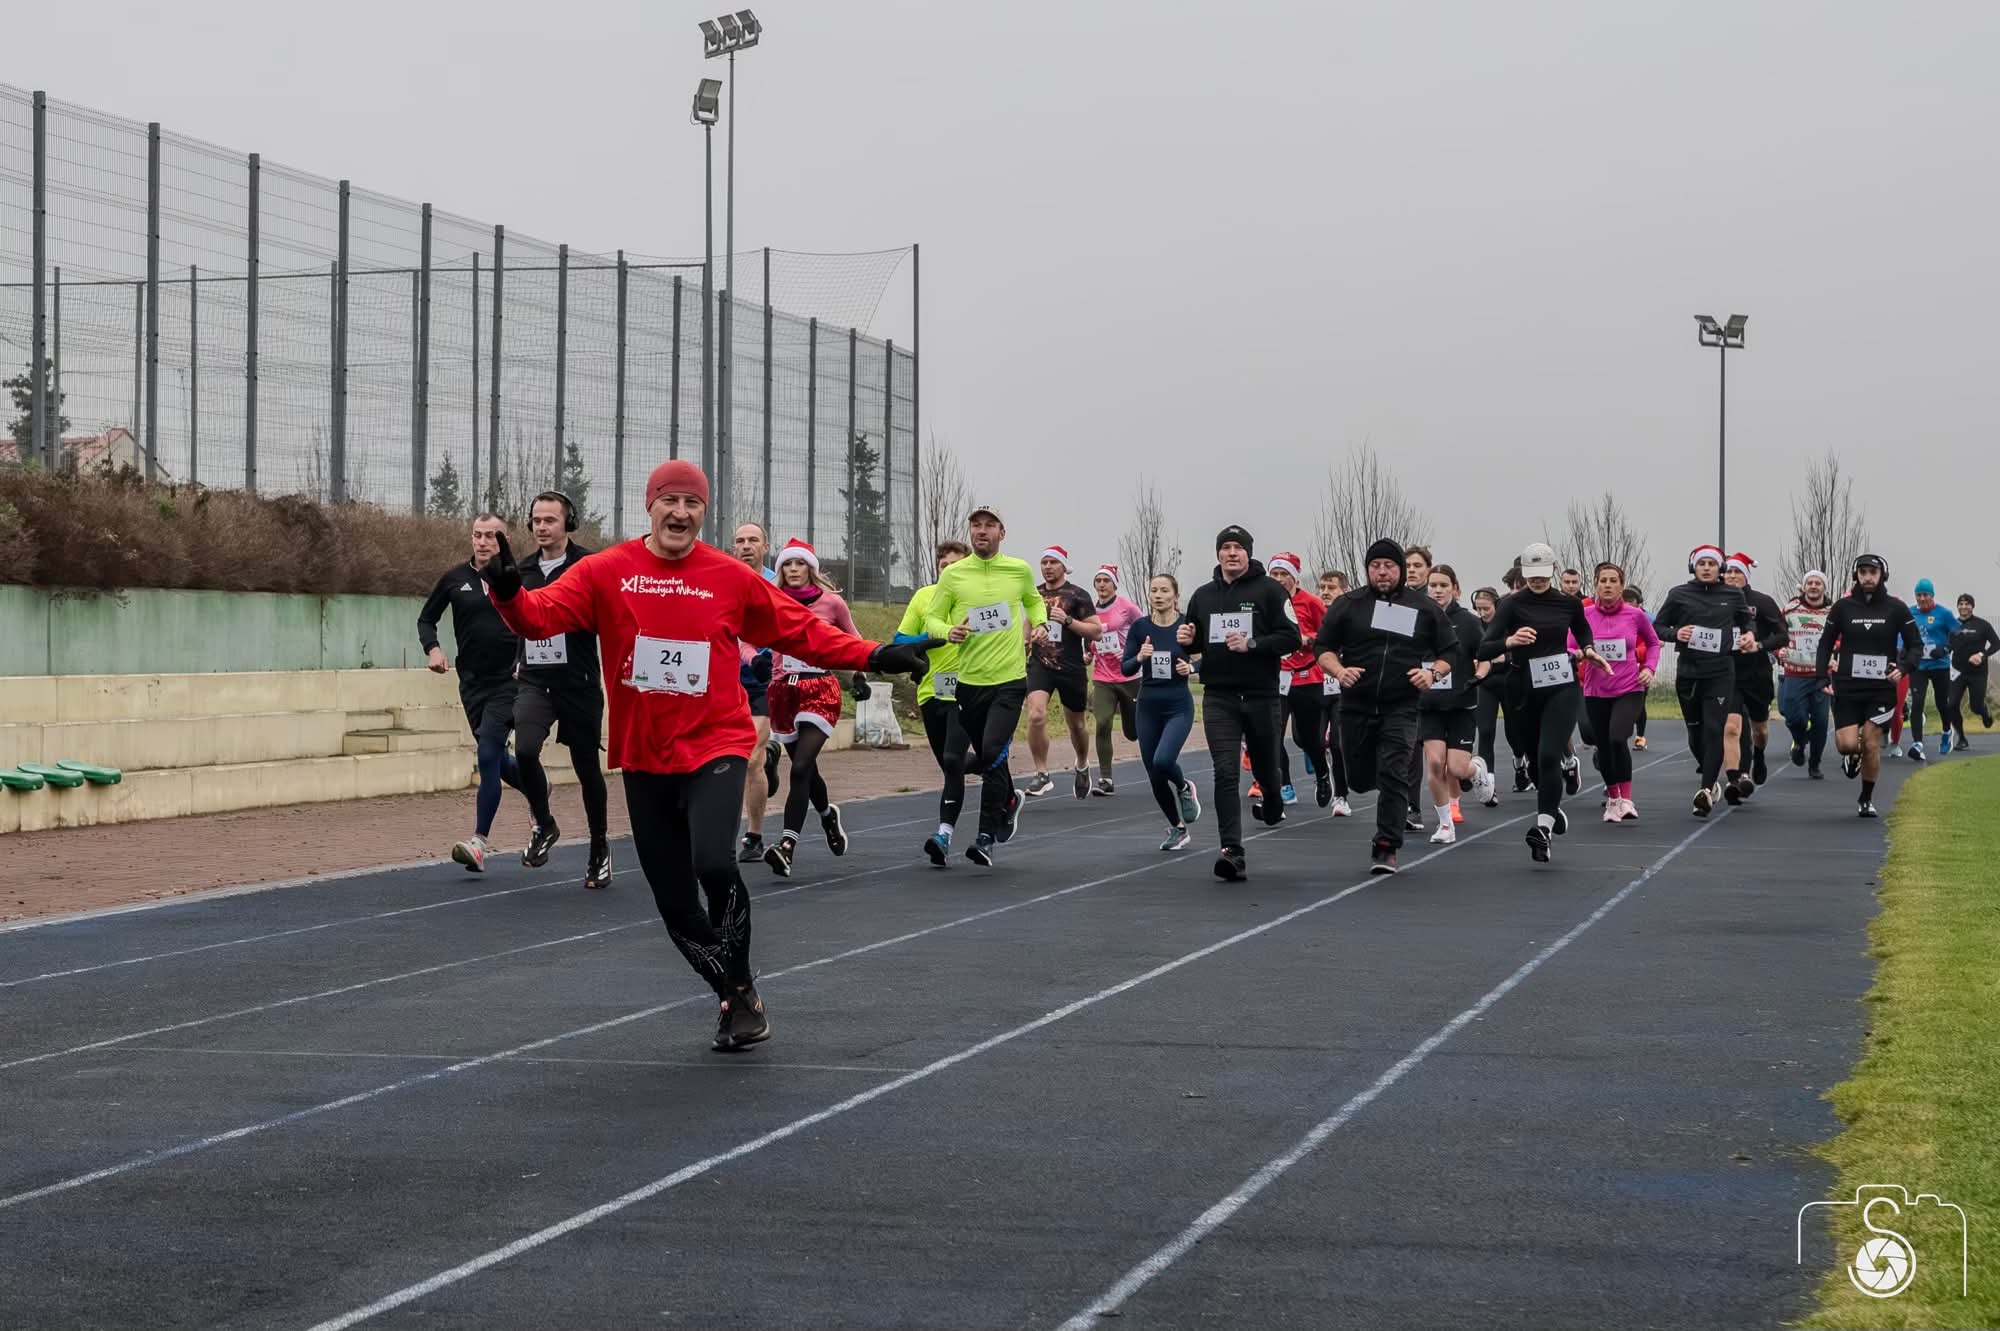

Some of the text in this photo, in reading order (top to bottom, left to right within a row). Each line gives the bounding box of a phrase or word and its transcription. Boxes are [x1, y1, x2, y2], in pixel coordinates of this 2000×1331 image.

[620, 575, 638, 593] XI
[979, 609, 999, 621] 134
[1221, 618, 1240, 629] 148
[1698, 631, 1714, 641] 119
[535, 638, 553, 648] 101
[660, 649, 683, 667] 24
[1153, 656, 1170, 665] 129
[1541, 660, 1560, 672] 103
[1862, 659, 1878, 668] 145
[944, 677, 957, 686] 20
